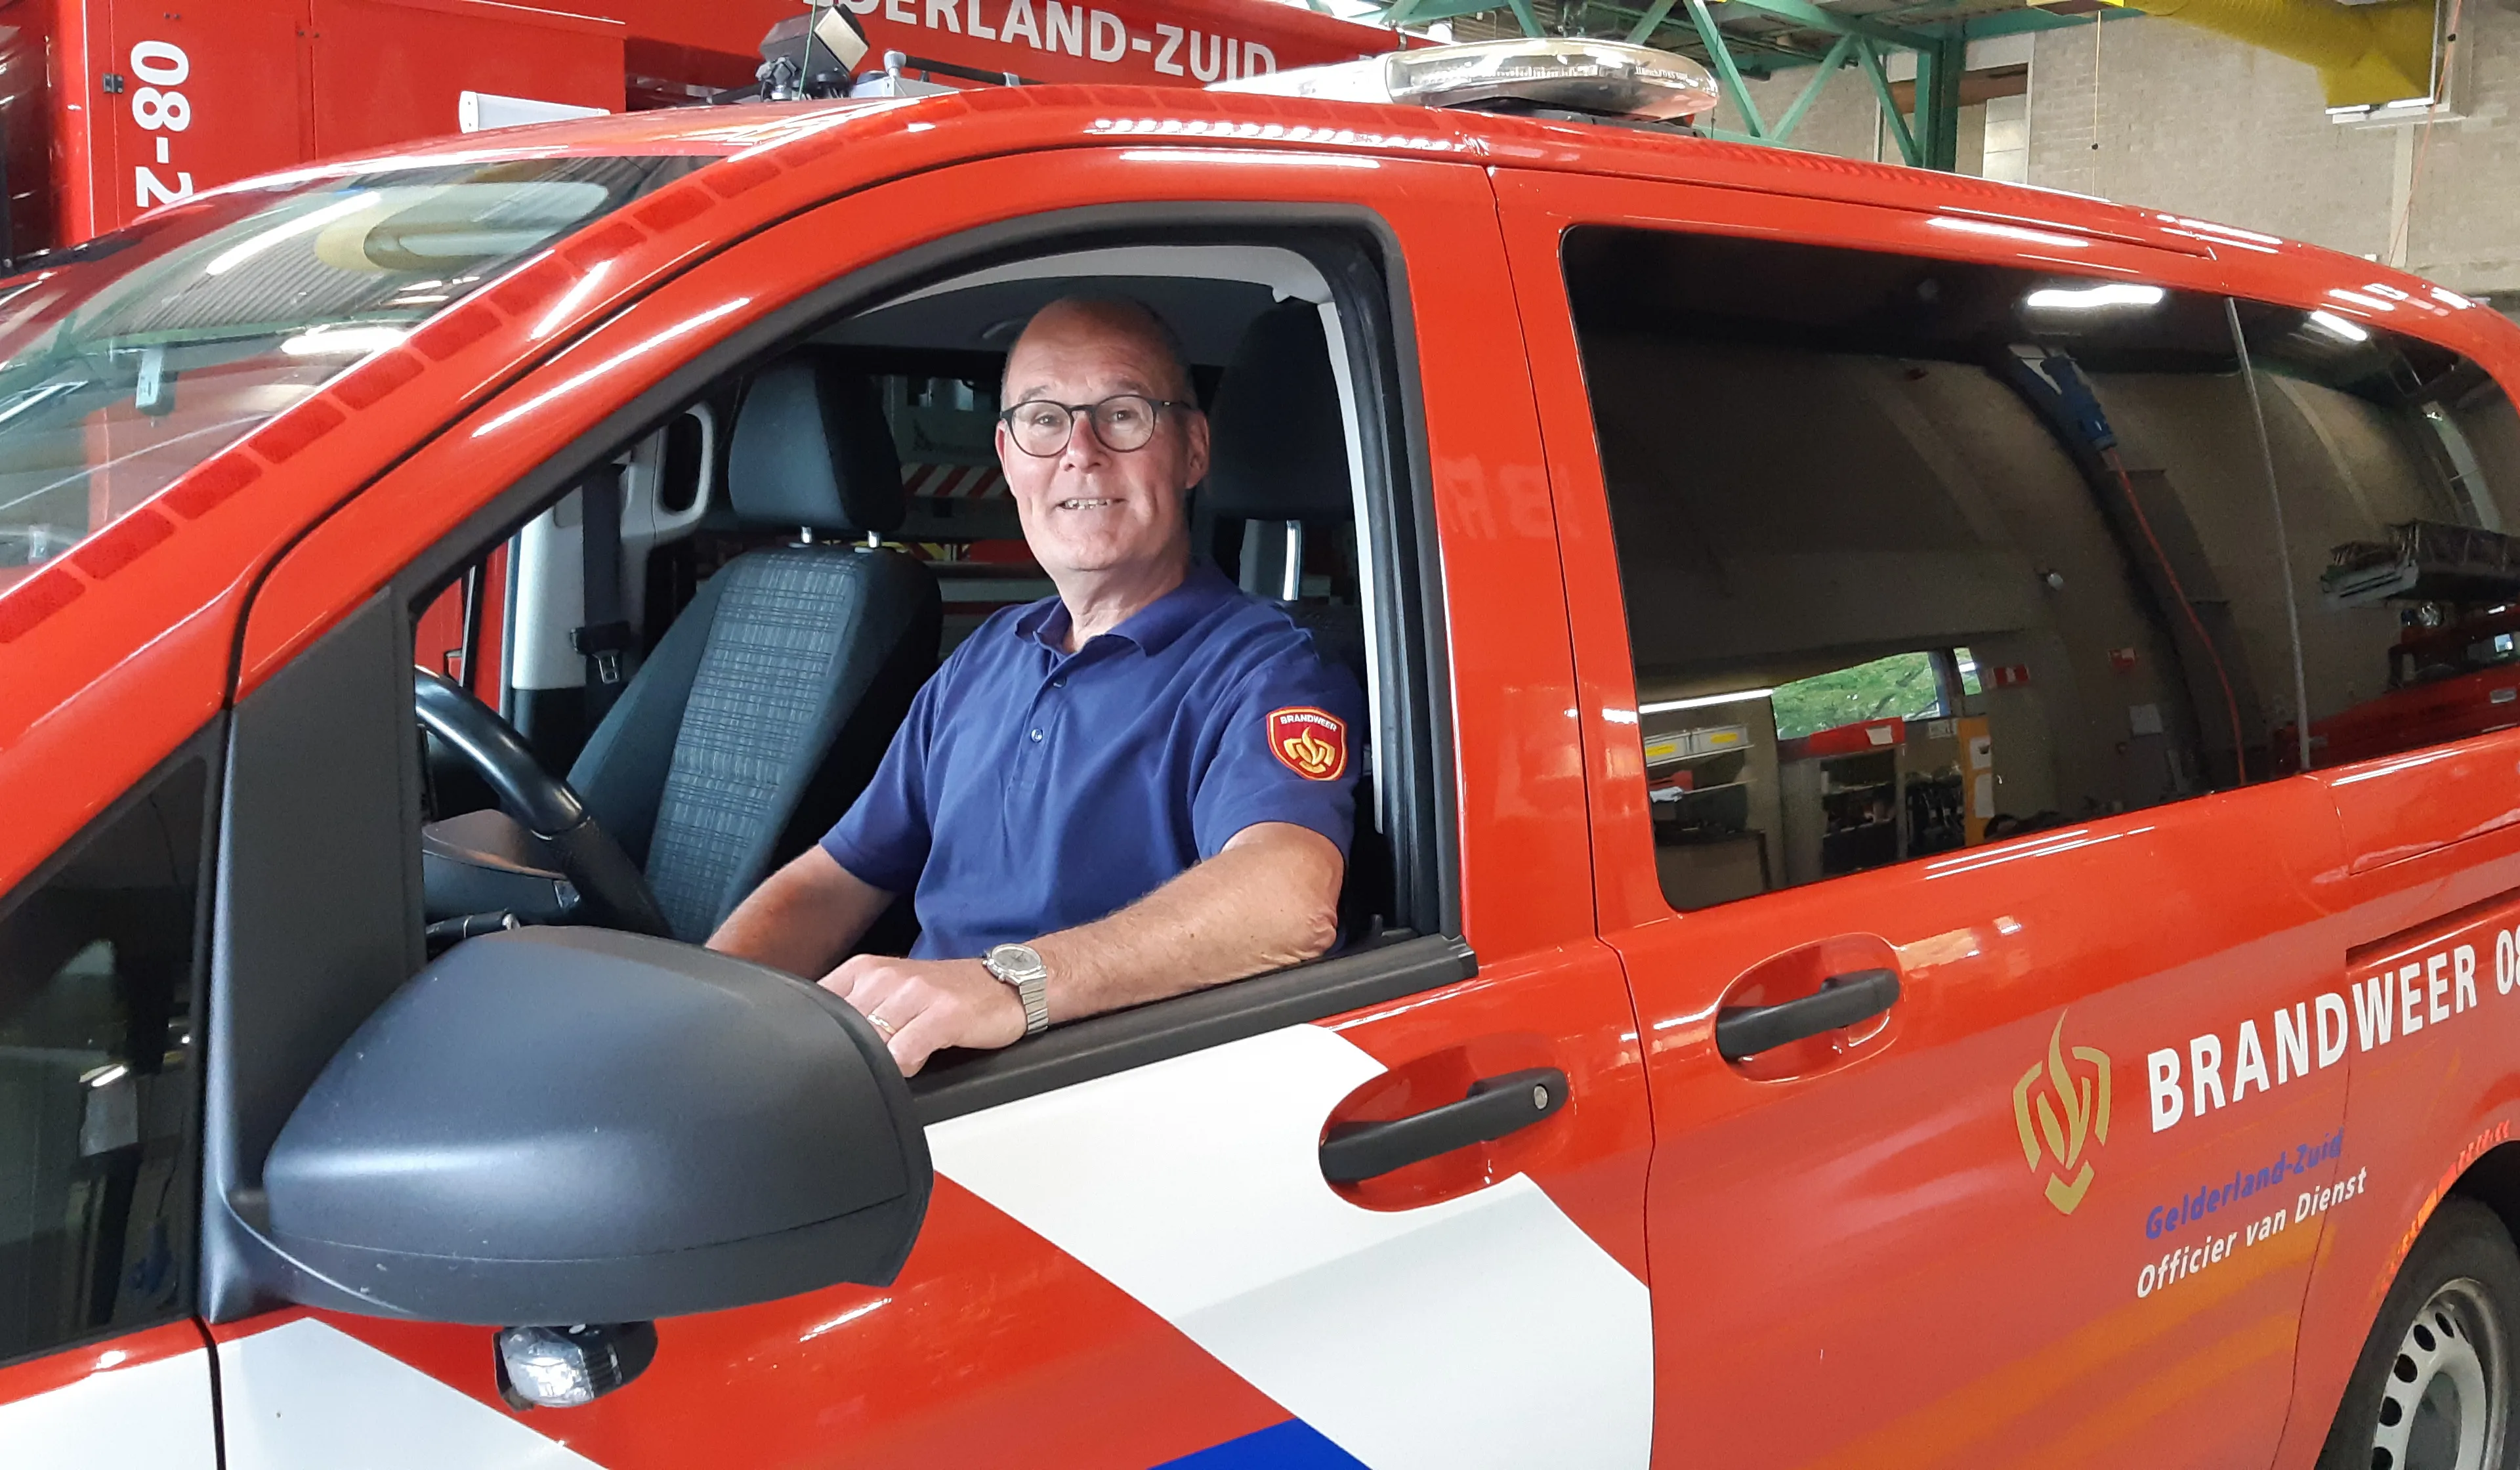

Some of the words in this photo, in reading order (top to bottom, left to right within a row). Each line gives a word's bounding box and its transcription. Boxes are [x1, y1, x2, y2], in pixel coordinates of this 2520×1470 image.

[803, 0, 1276, 83] RLAND-ZUID
[1280, 714, 1337, 732] BRANDWEER
[2147, 944, 2477, 1133] BRANDWEER
[2496, 924, 2520, 995] 0
[2136, 1230, 2237, 1299] Officier
[2245, 1210, 2286, 1248] van
[2294, 1167, 2366, 1225] Dienst
[2146, 1127, 2345, 1240] Gelderland-Zuid
